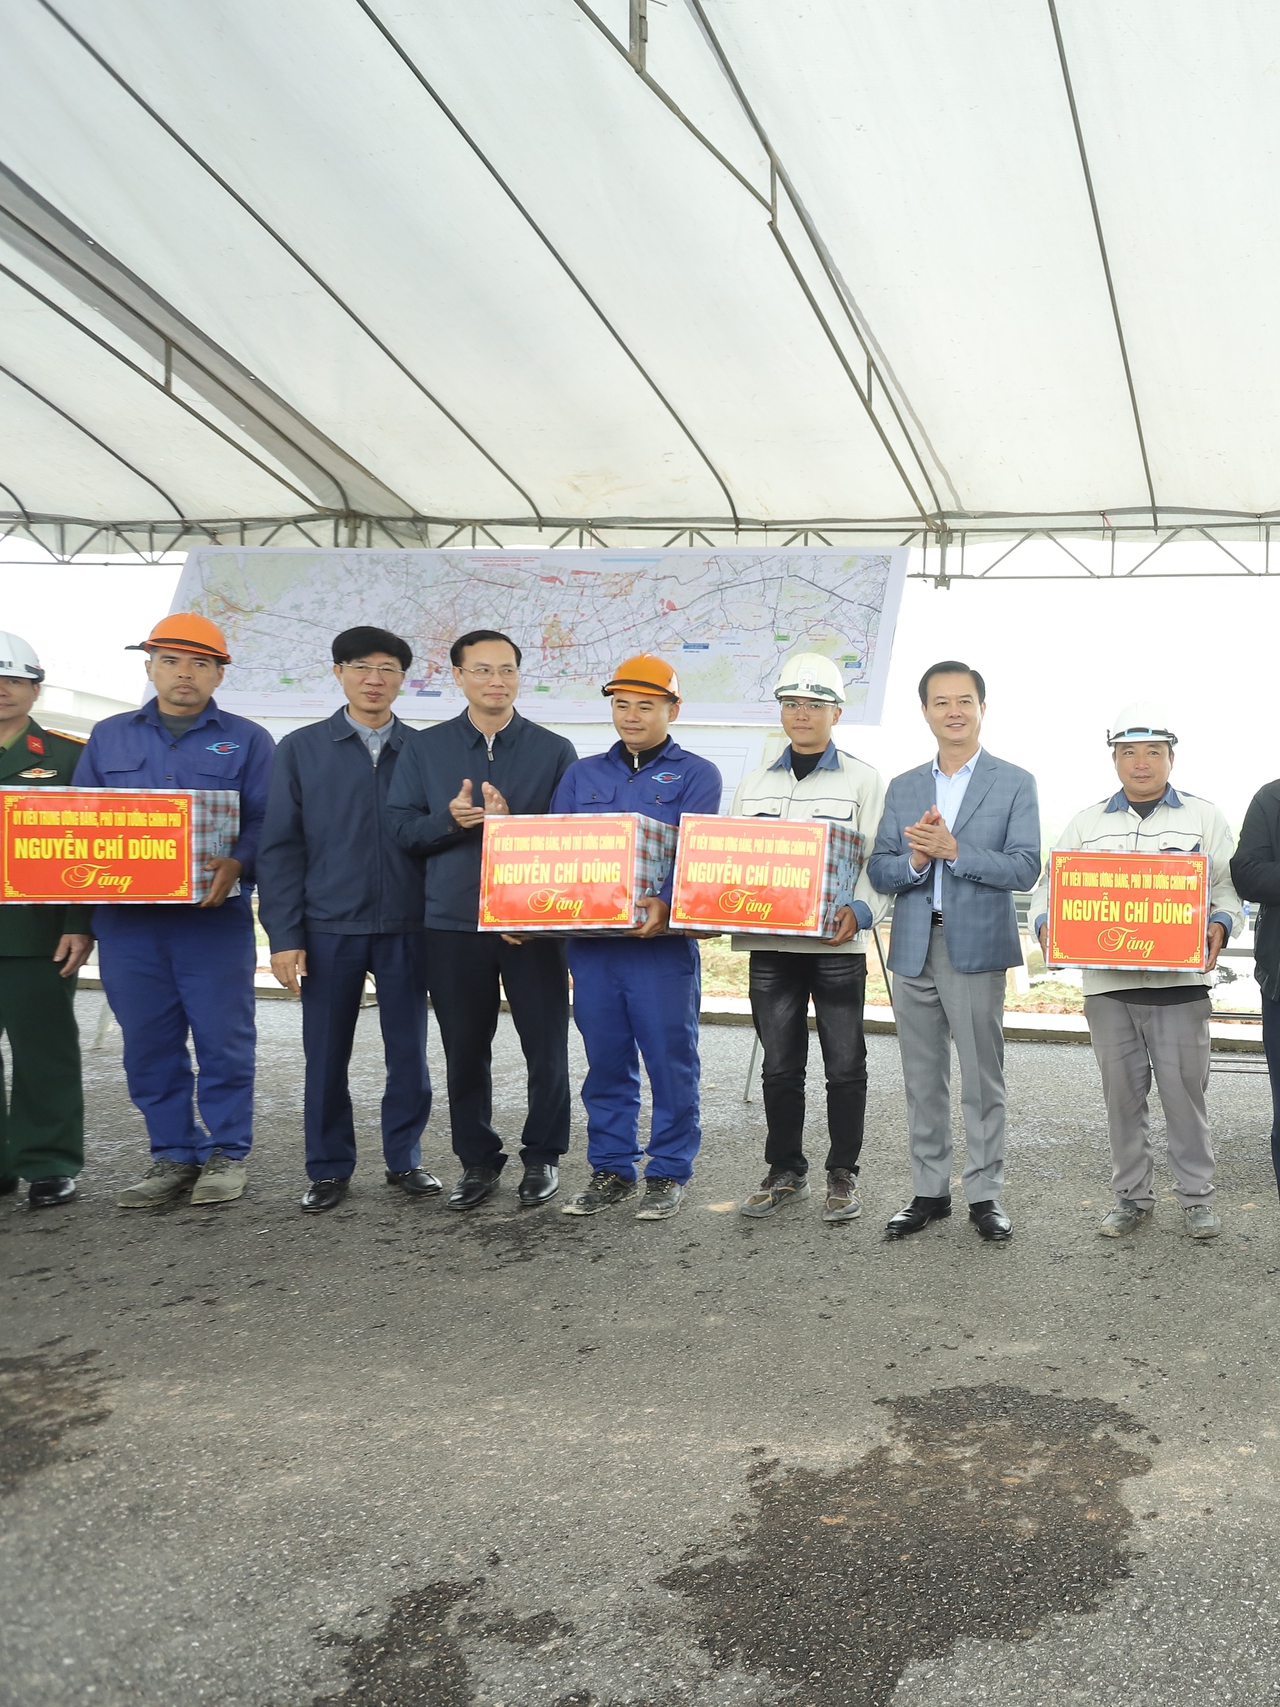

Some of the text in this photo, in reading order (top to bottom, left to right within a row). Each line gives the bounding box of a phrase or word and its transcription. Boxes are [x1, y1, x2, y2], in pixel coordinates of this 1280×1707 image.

[23, 808, 38, 825] VIÊN
[15, 830, 177, 860] NGUYỄN CHÍ DŨNG
[502, 835, 514, 852] VIÊN
[697, 833, 709, 850] VIÊN
[61, 864, 133, 893] Tặng
[494, 856, 622, 885] NGUYỄN CHÍ DŨNG
[687, 856, 811, 889] NGUYỄN CHÍ DŨNG
[1070, 869, 1082, 886] VIÊN
[1083, 872, 1099, 887] TRUNG
[1131, 871, 1141, 889] PHÓ
[528, 888, 584, 918] Tặng
[720, 889, 773, 921] Tặng
[1062, 892, 1193, 924] NGUYỄN CHÍ DŨNG
[1098, 927, 1155, 958] Tặng
